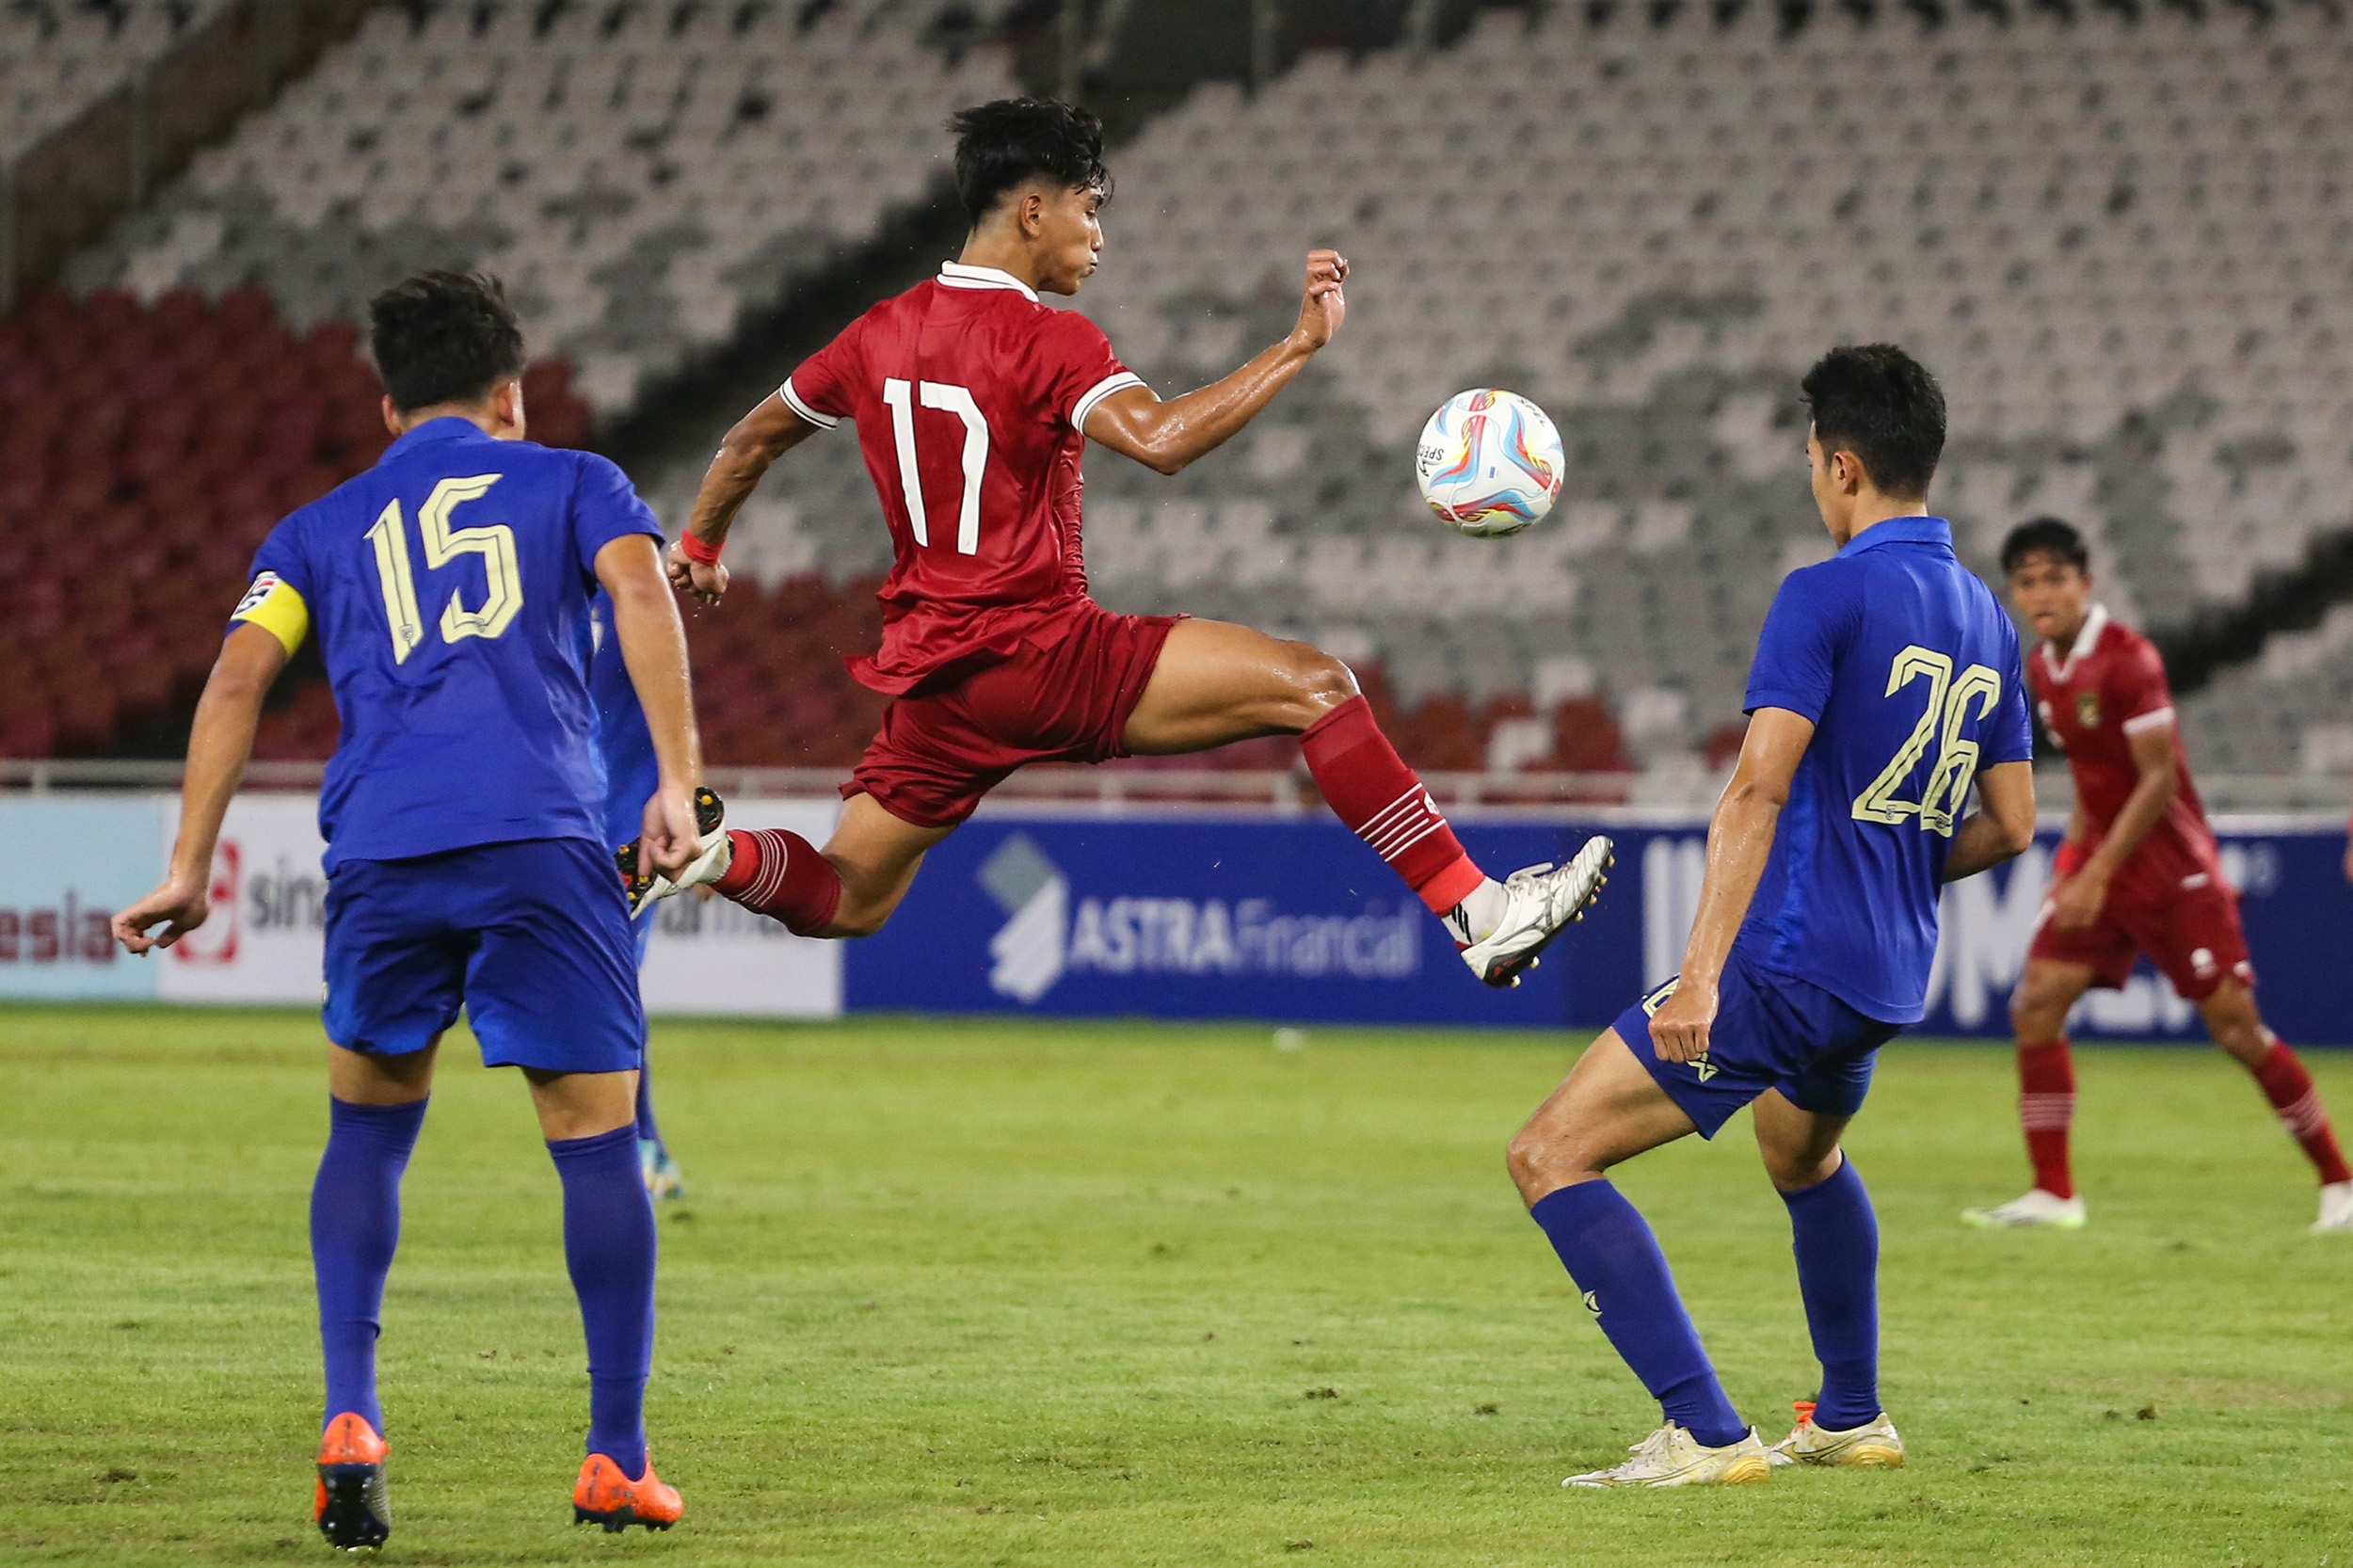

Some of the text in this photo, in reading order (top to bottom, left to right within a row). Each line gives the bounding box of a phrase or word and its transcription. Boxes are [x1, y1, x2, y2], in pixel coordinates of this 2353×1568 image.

[882, 376, 990, 556] 17
[362, 472, 525, 666] 15
[1850, 645, 2002, 839] 26
[1071, 897, 1237, 973] ASTRA
